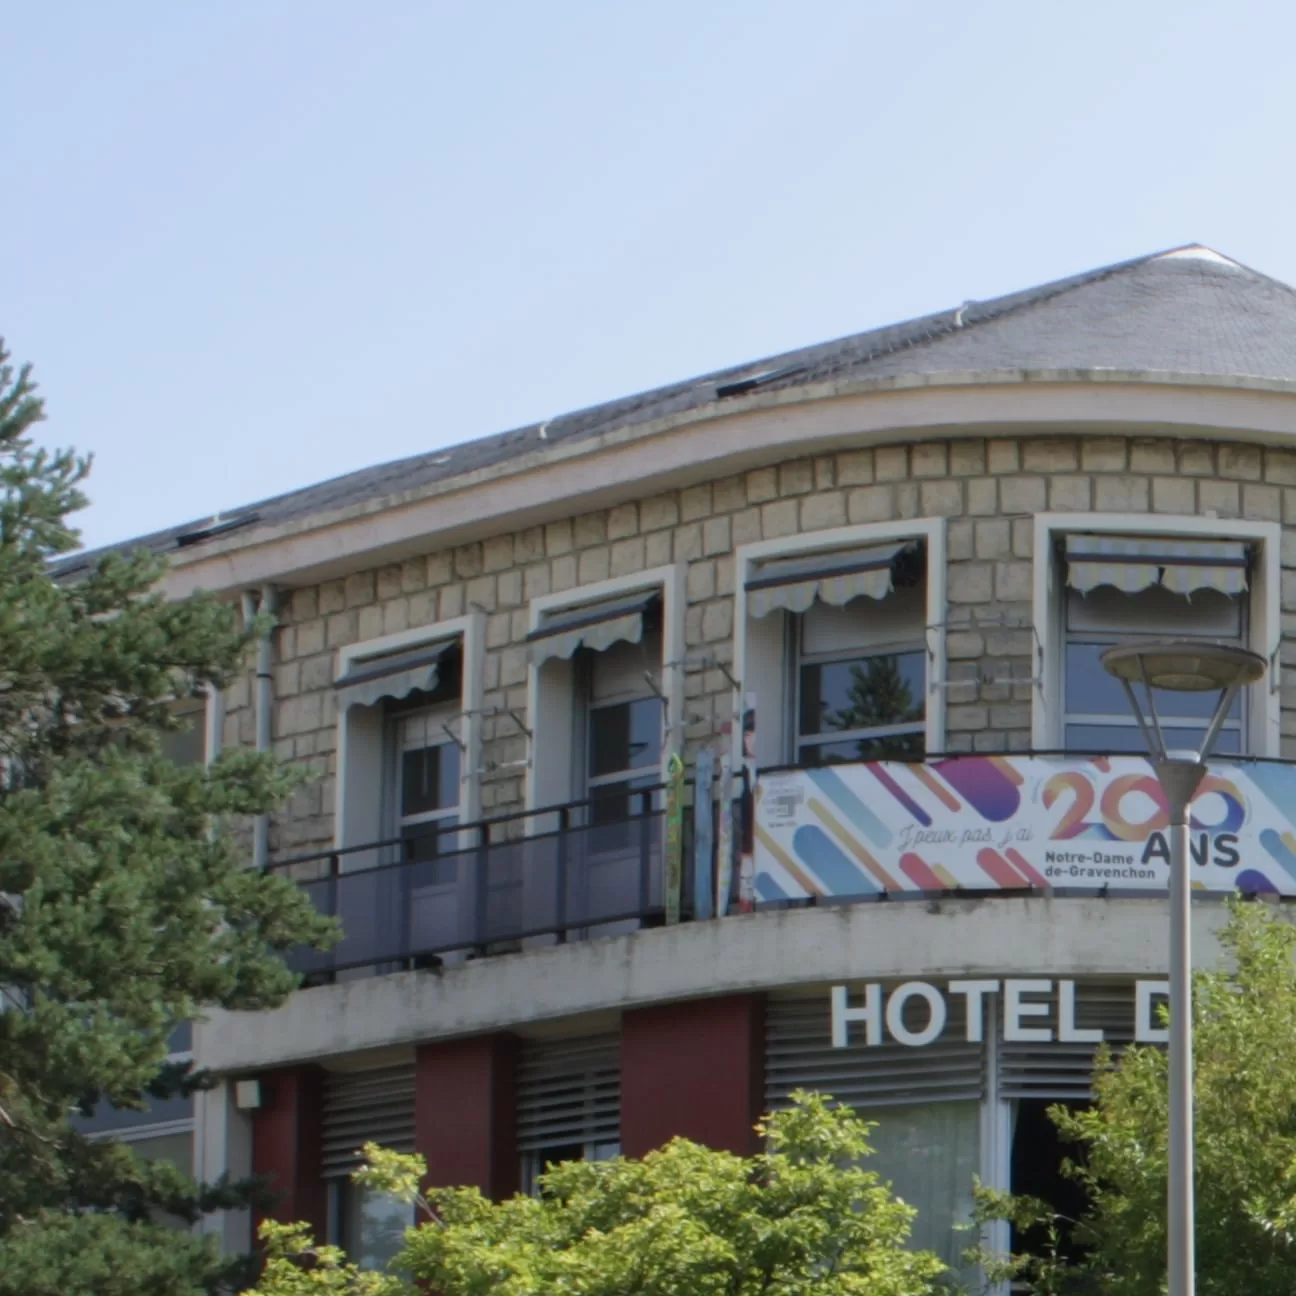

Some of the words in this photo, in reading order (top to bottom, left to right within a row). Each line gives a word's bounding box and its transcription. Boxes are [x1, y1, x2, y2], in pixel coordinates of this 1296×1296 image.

[1042, 771, 1246, 842] 200
[1045, 851, 1134, 865] Notre-Dame
[1045, 865, 1156, 880] de-Gravenchon
[831, 979, 1104, 1048] HOTEL
